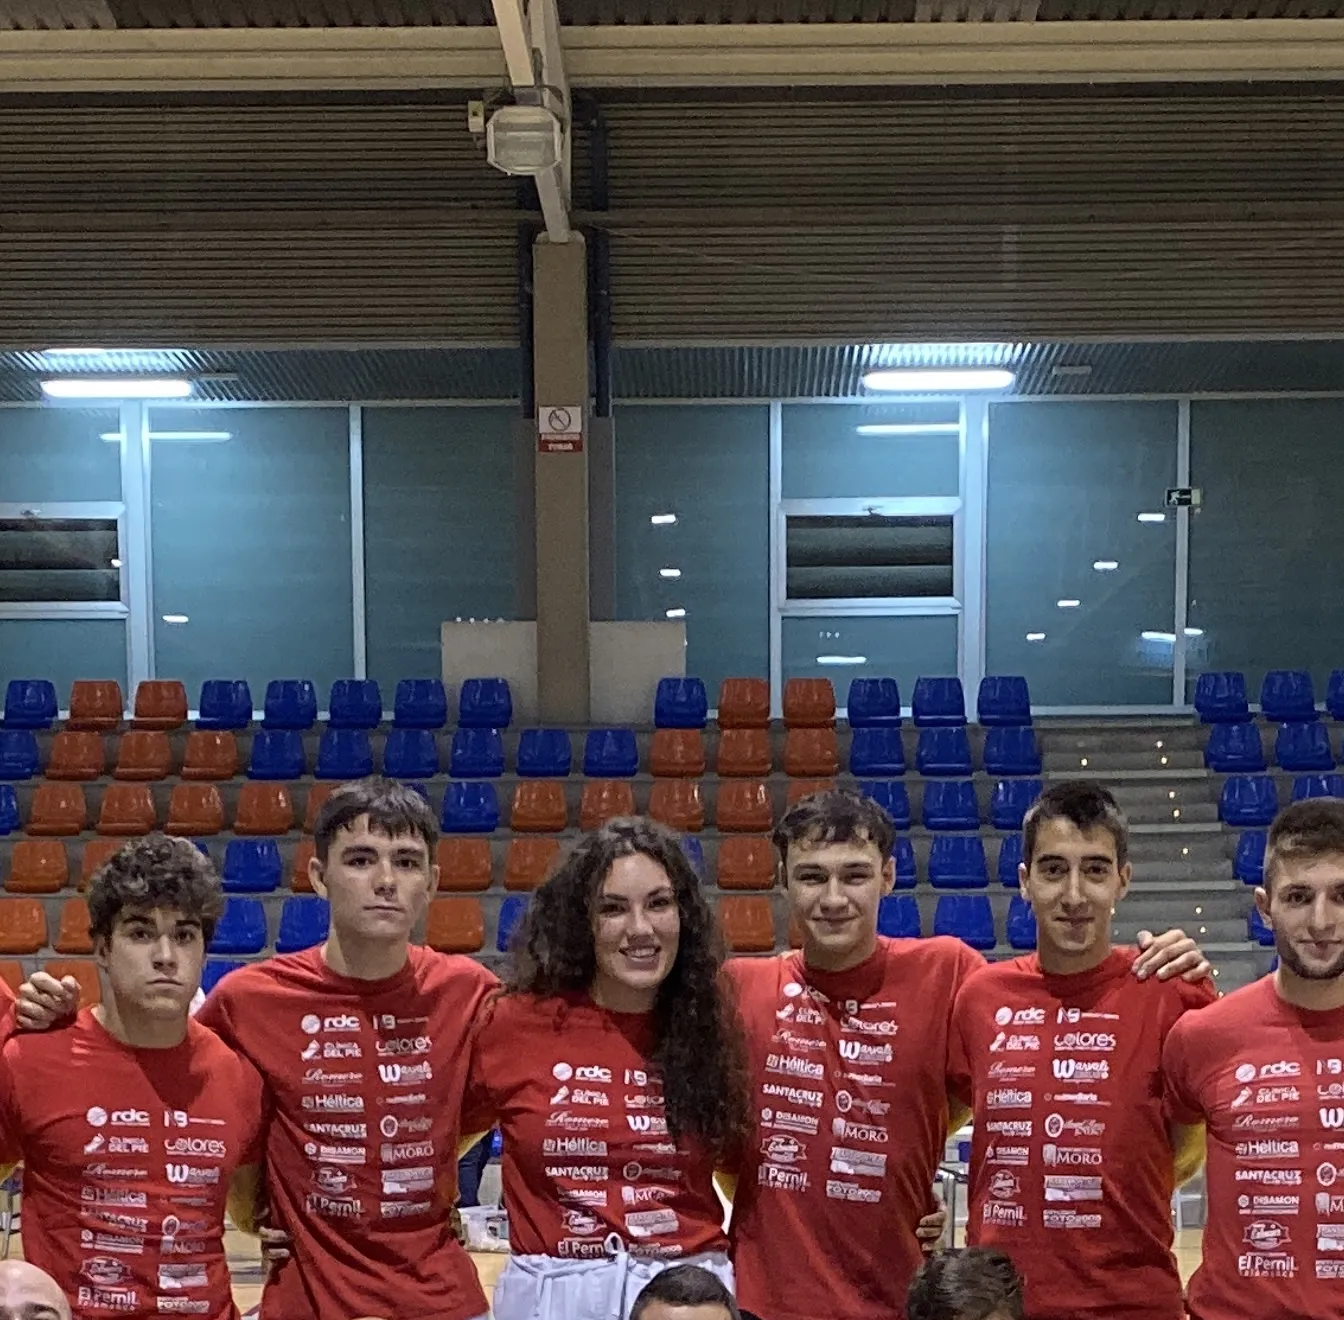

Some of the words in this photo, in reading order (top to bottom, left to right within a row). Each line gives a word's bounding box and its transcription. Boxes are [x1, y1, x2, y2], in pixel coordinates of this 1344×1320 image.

[1014, 1008, 1046, 1021] rdc
[324, 1015, 361, 1029] rdc
[1260, 1061, 1300, 1075] rdc
[111, 1109, 150, 1123] rdc
